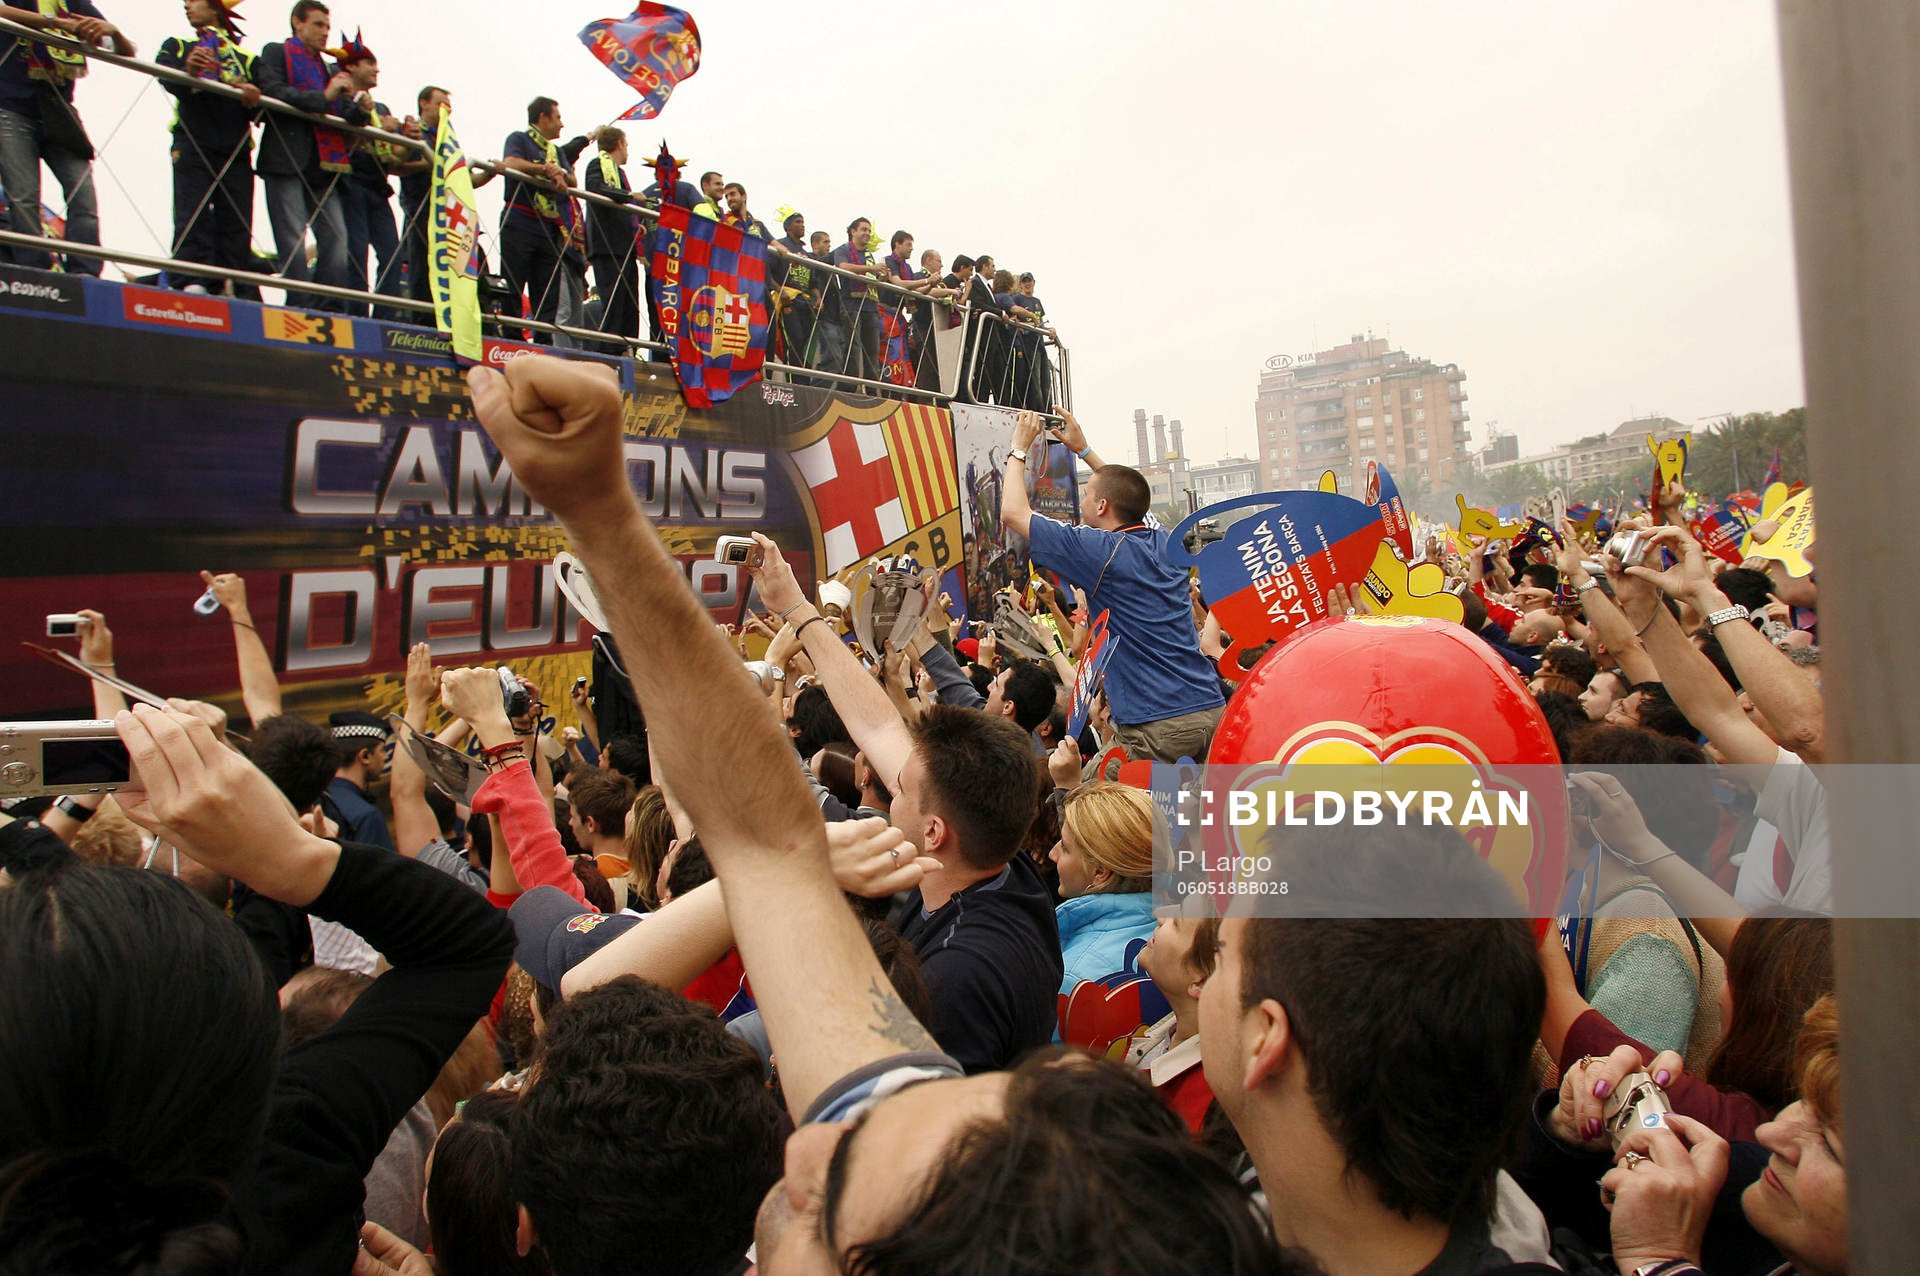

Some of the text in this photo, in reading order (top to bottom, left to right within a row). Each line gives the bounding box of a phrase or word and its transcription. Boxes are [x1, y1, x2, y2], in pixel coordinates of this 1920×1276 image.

[134, 303, 224, 326] Estrella Damm
[304, 314, 335, 345] 3
[714, 307, 724, 336] FCB
[386, 330, 452, 351] Telefónica
[1270, 358, 1288, 367] KIA
[1297, 353, 1314, 362] KIA
[292, 418, 767, 519] CAMONS
[1253, 520, 1311, 629] LA SEGONA
[1278, 514, 1325, 614] FELICITATS BARÇA
[1237, 540, 1289, 624] JA TENIM
